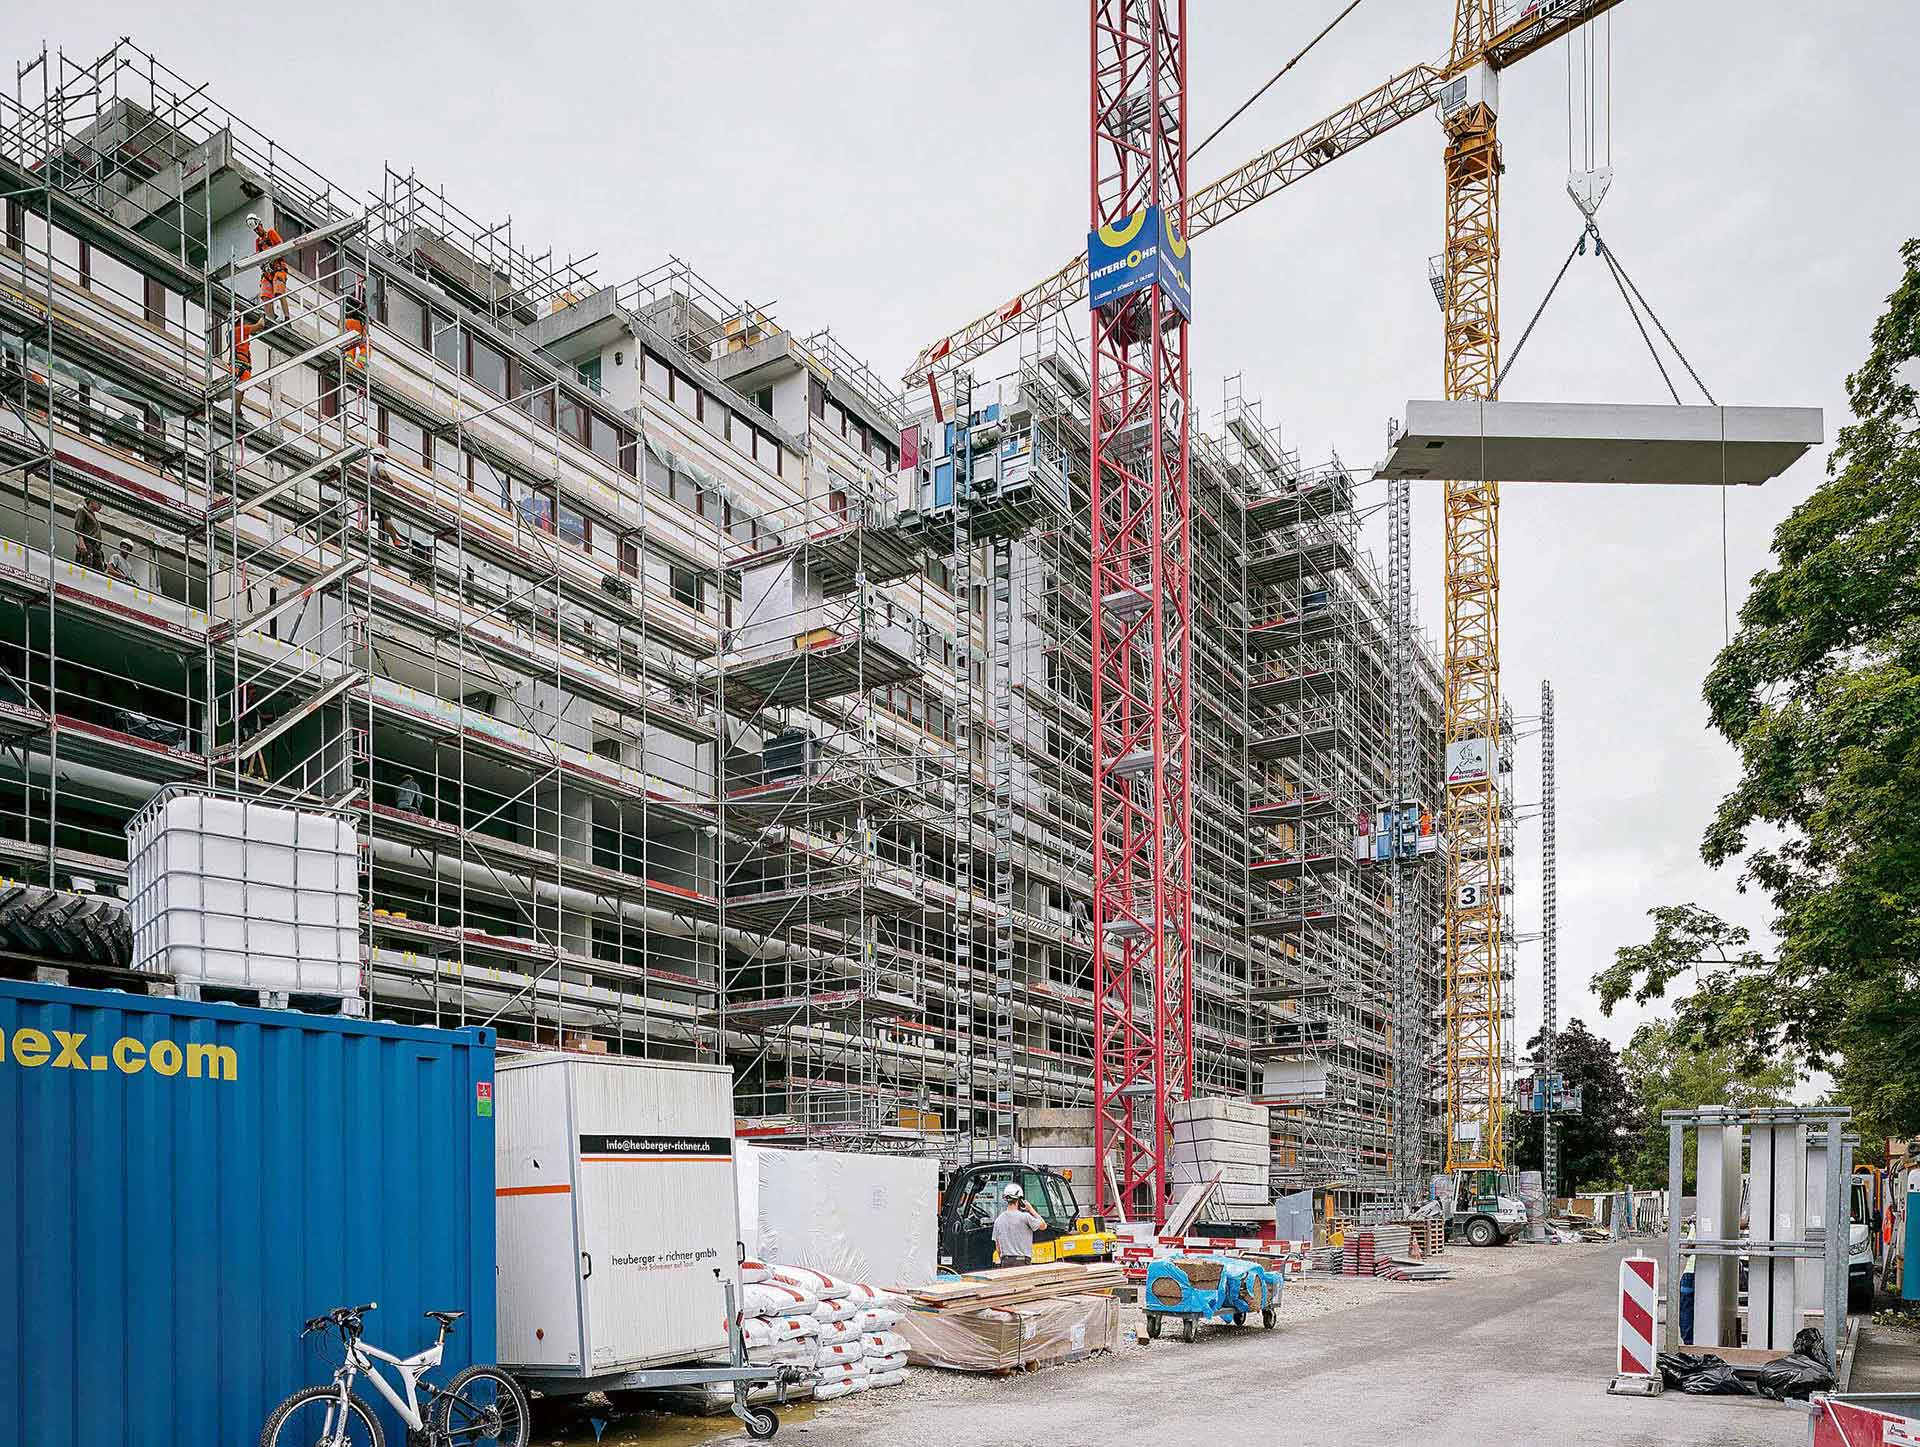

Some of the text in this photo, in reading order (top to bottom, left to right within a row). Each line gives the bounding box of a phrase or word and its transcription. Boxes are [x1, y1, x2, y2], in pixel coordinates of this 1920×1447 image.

[1090, 246, 1157, 280] INTERBOHR
[1462, 887, 1476, 905] 3
[0, 1025, 238, 1081] ex.com
[612, 1254, 656, 1266] heuberger
[666, 1250, 693, 1262] richner
[695, 1248, 717, 1262] gmbh
